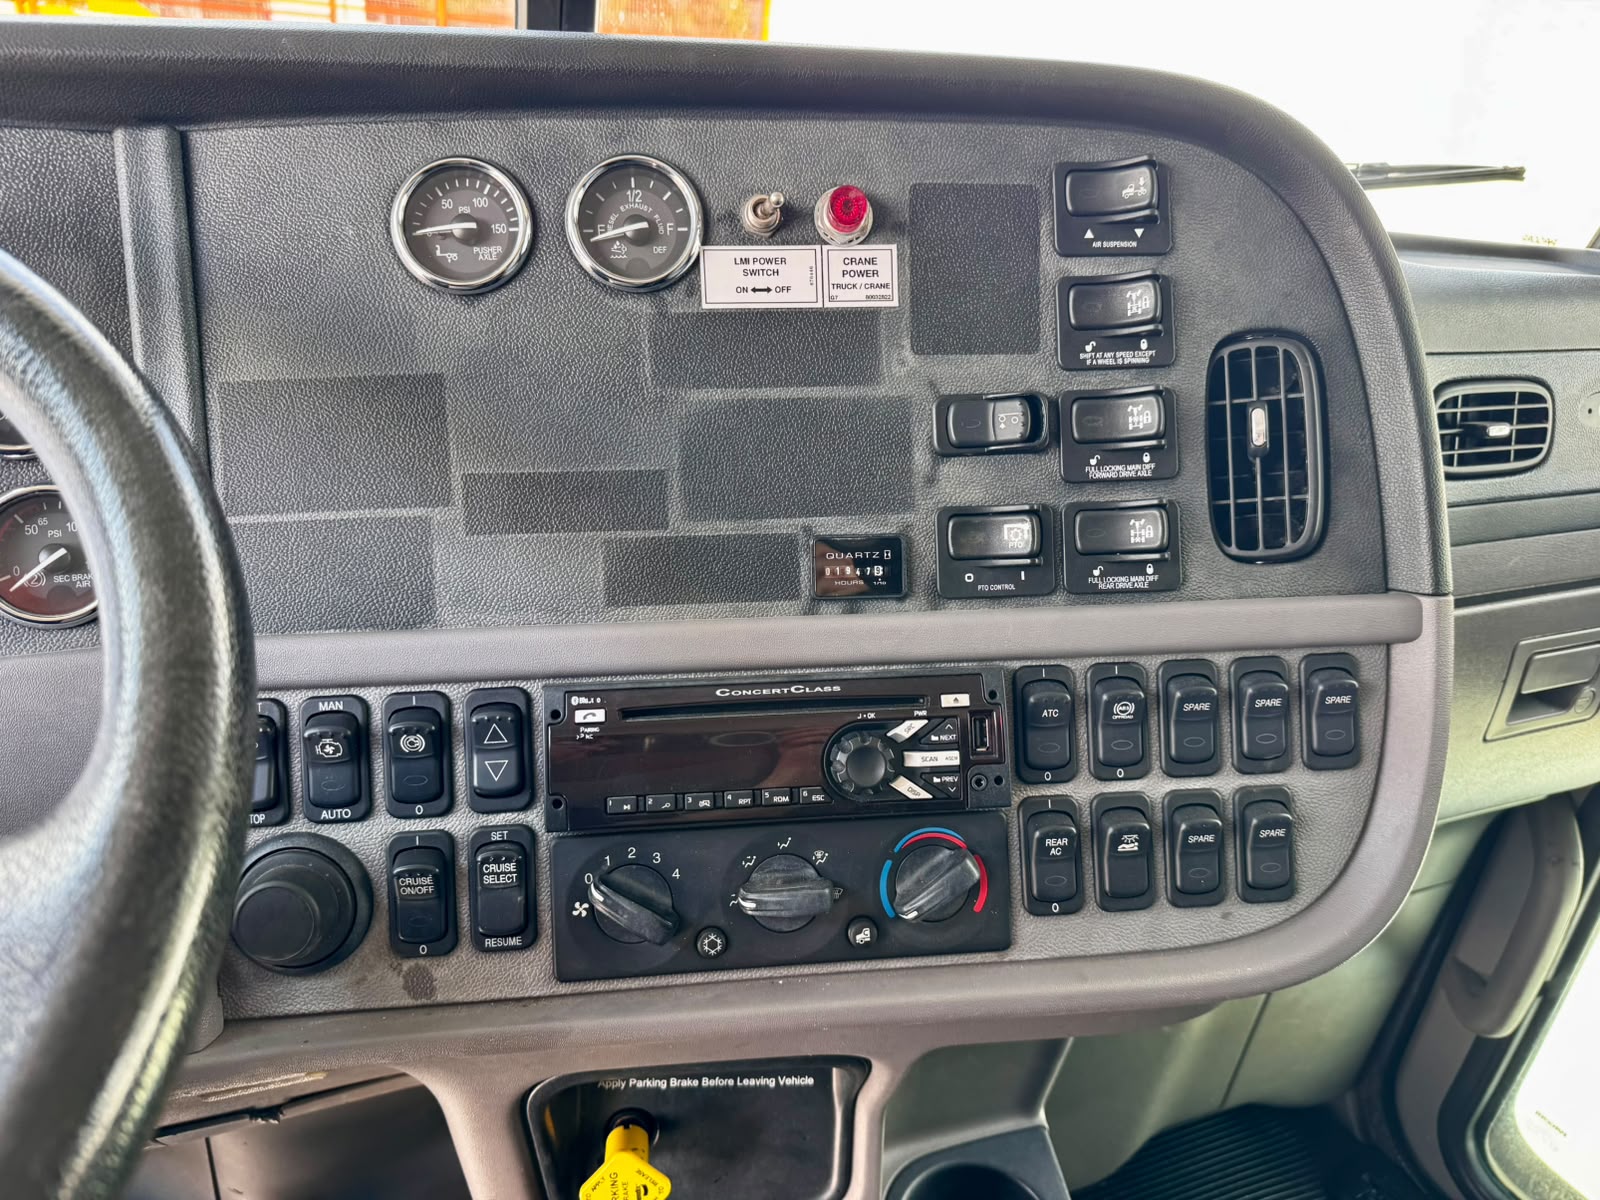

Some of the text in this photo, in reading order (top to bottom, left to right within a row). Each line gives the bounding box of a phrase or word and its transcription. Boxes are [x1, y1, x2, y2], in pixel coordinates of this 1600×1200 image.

[626, 190, 642, 202] 1/2
[441, 199, 453, 209] 50
[472, 198, 488, 208] 100
[620, 203, 653, 213] EXHAUST
[653, 214, 665, 234] FLUID
[491, 224, 506, 234] 150
[666, 223, 674, 236] F
[1103, 240, 1137, 248] SUSPENSION
[473, 246, 502, 254] PUSHER
[653, 246, 667, 254] DEF
[734, 257, 787, 265] LMI POWER
[843, 257, 878, 266] CRANE
[742, 268, 780, 276] SWITCH
[842, 270, 879, 278] POWER
[735, 286, 792, 294] ON OFF
[38, 517, 48, 526] 65
[66, 521, 78, 532] 10
[25, 524, 38, 535] 50
[48, 530, 62, 538] PSI
[826, 552, 880, 560] QUARTZ
[13, 566, 20, 576] 0
[53, 573, 94, 583] SEC BRAK
[76, 580, 91, 588] AIR
[1254, 699, 1283, 707] SPARE
[1325, 696, 1352, 705] SPARE
[319, 701, 343, 712] MAN
[1183, 702, 1211, 711] SPARE
[1042, 709, 1059, 718] ATC
[249, 814, 265, 824] TOP
[320, 808, 351, 820] AUTO
[491, 831, 509, 841] SET
[1259, 829, 1286, 838] SPARE
[1045, 838, 1068, 847] REAR
[1187, 834, 1215, 844] SPARE
[627, 848, 636, 858] 2
[1050, 847, 1062, 856] AC
[604, 855, 610, 866] 1
[653, 853, 661, 863] 3
[483, 862, 517, 873] CRUISE
[483, 873, 518, 884] SELECT
[584, 874, 593, 884] 0
[672, 869, 681, 879] 4
[399, 876, 434, 885] CRUISE
[400, 886, 434, 895] ON/OFF
[485, 936, 523, 948] RESUME
[598, 1076, 814, 1089] Apply Parking Brake Before Leaving Vehicle
